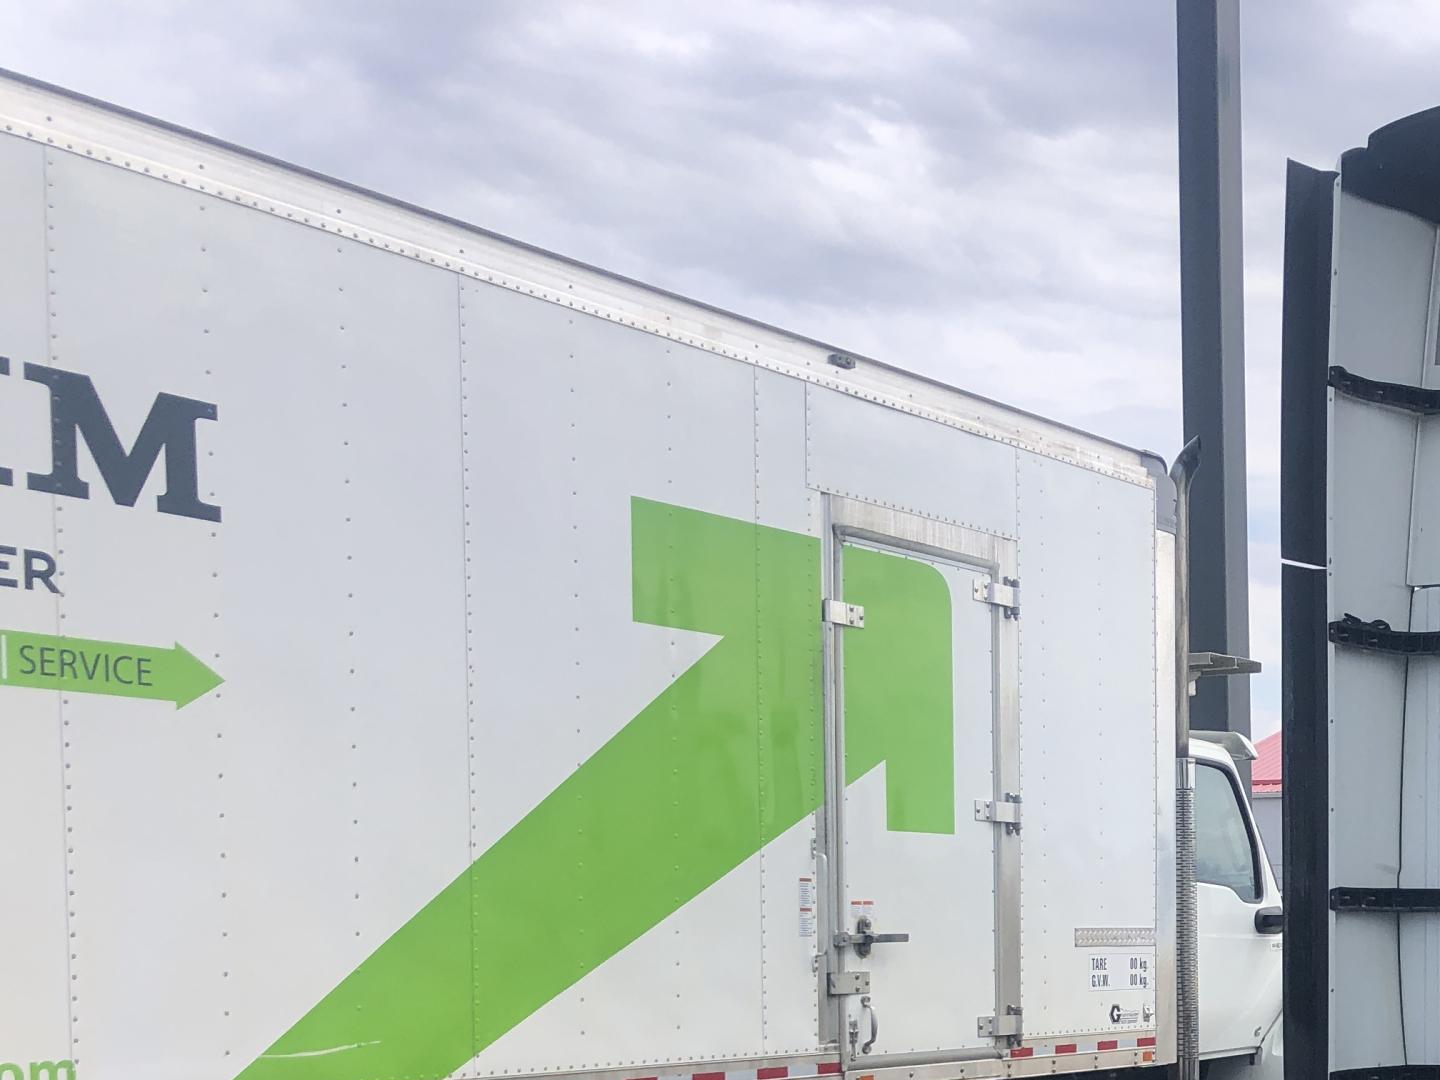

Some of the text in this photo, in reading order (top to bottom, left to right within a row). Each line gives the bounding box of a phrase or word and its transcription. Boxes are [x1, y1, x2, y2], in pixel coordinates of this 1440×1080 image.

[0, 356, 222, 523] M
[18, 644, 154, 686] SERVICE
[1091, 957, 1108, 971] TARE
[1129, 957, 1138, 970] 00
[1091, 974, 1111, 988] G.V.W.
[1129, 974, 1138, 986] 00
